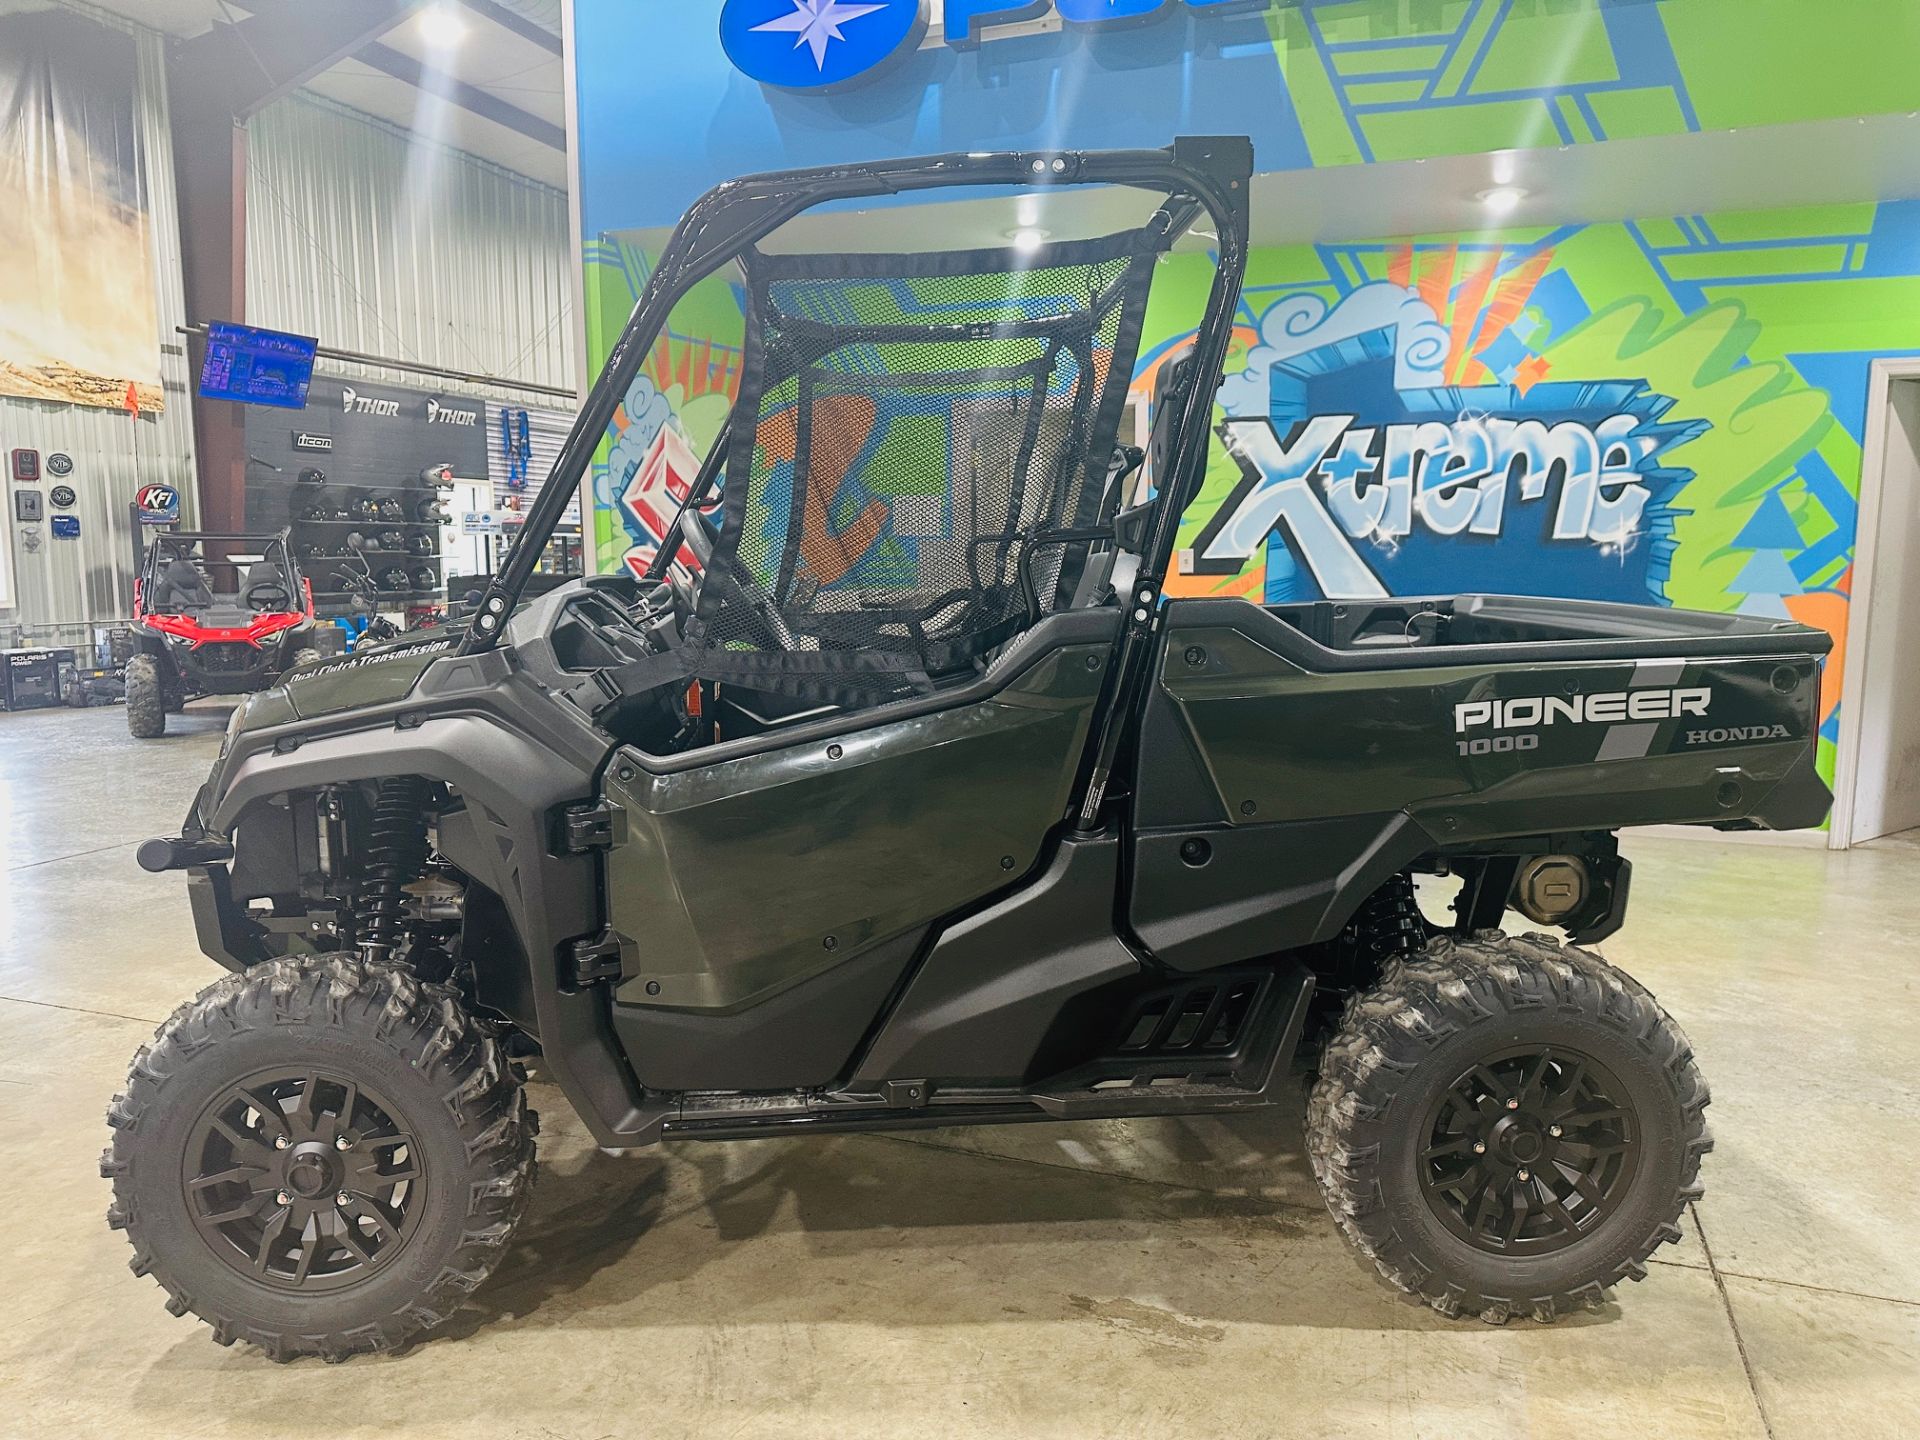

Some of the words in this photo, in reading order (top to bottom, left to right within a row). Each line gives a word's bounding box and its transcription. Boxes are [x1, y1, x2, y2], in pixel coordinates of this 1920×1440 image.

[356, 396, 400, 417] THOR
[438, 408, 477, 426] THOR
[1200, 414, 1652, 599] Xtreme
[10, 654, 47, 662] POLARIS
[290, 669, 315, 683] Dual
[317, 658, 358, 677] Clutch
[359, 640, 451, 667] Transmission
[1455, 687, 1712, 733] PIONEER
[1456, 734, 1539, 757] 1000
[1686, 724, 1792, 745] HONDA
